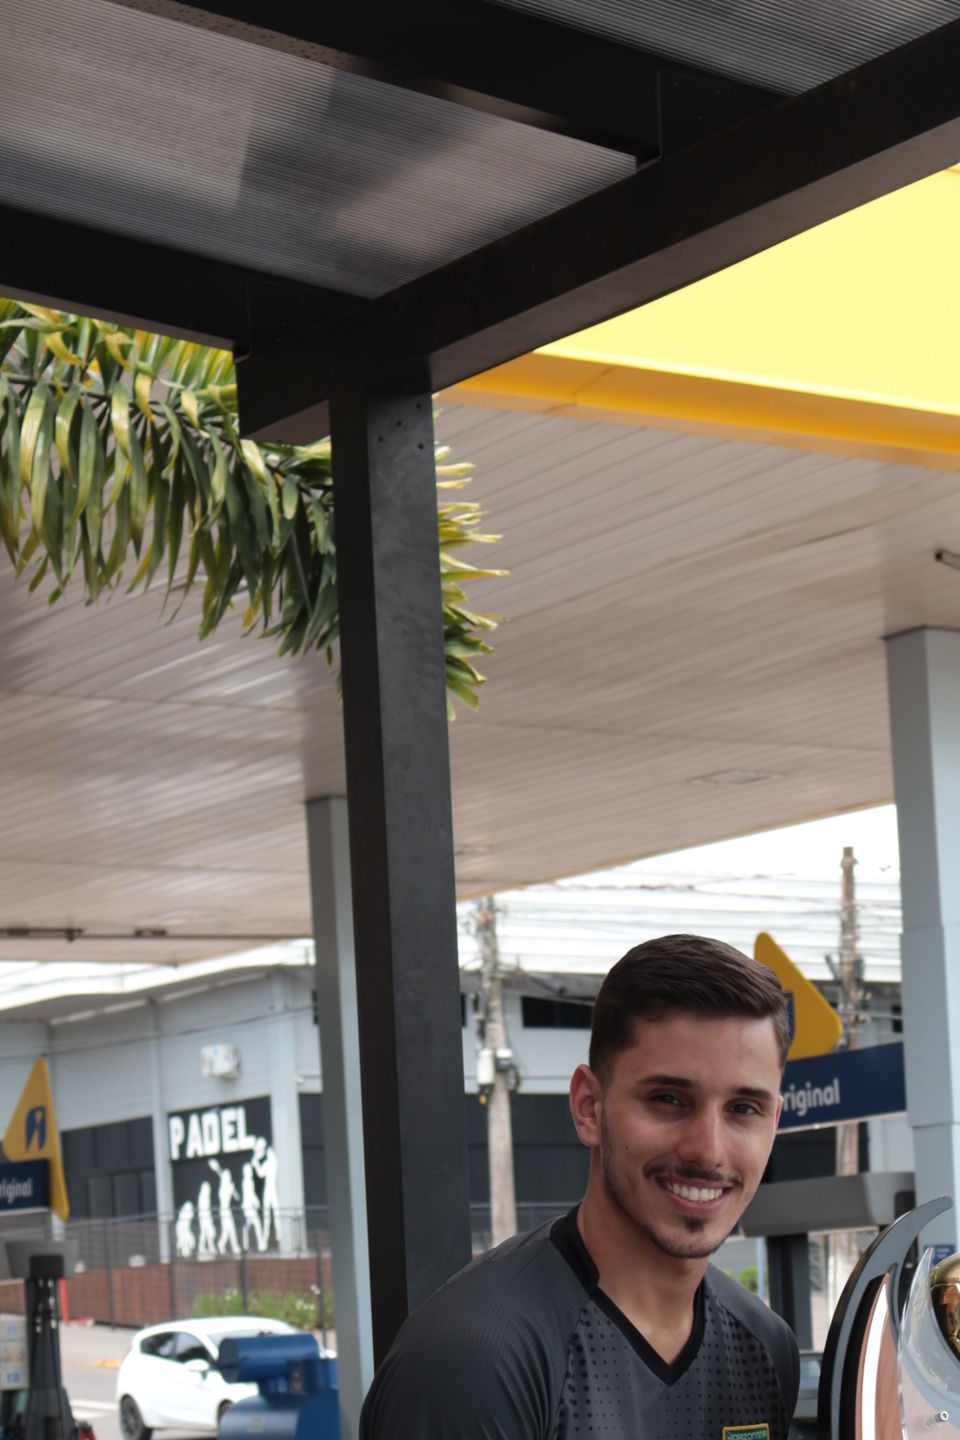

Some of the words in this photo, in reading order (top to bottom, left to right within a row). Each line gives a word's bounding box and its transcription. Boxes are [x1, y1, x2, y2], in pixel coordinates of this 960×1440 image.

[783, 1077, 841, 1117] riginal
[169, 1106, 257, 1159] PADEL
[0, 1177, 33, 1203] riginal
